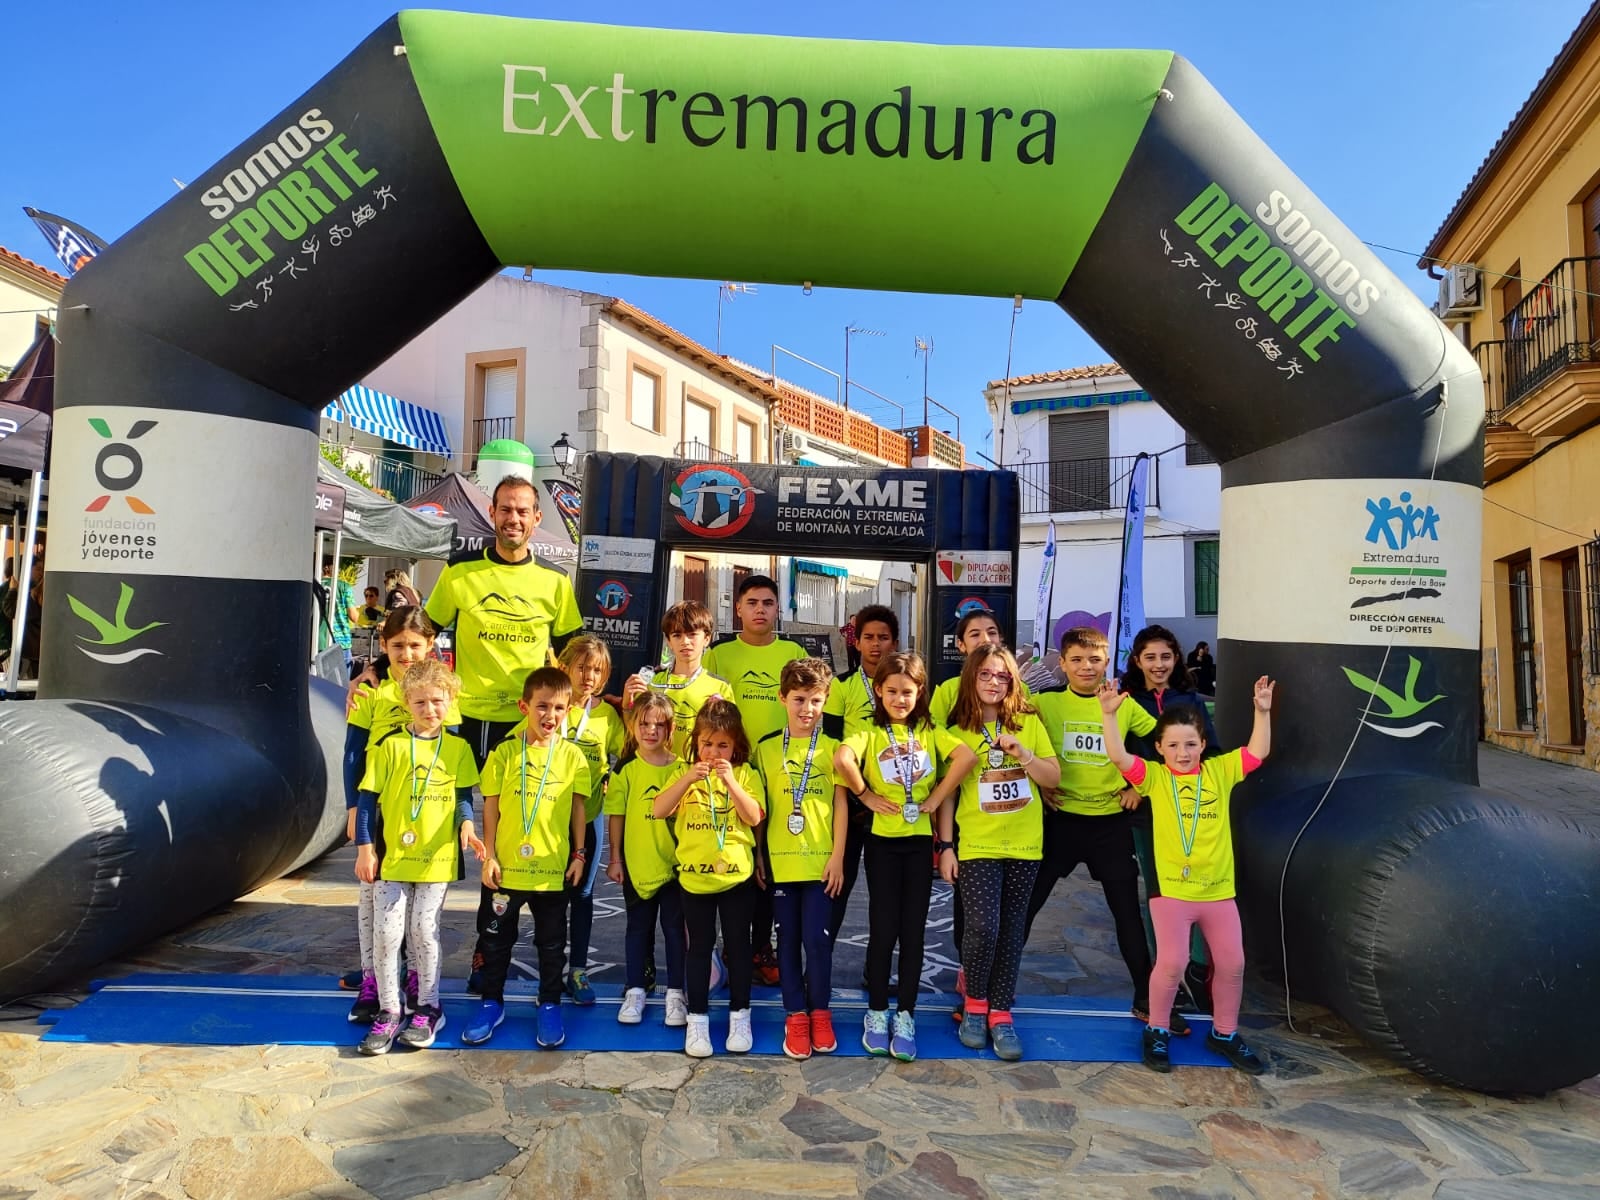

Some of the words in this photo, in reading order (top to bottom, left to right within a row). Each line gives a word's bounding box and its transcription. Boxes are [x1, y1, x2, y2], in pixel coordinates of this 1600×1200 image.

[502, 64, 1057, 166] Extremadura
[183, 132, 379, 297] DEPORTE
[1174, 181, 1357, 362] DEPORTE
[777, 476, 927, 509] FEXME
[777, 507, 850, 521] FEDERACIÓN
[856, 509, 925, 522] EXTREMEÑA
[84, 517, 156, 531] fundación
[777, 521, 793, 533] DE
[795, 521, 850, 535] MONTAÑA
[853, 523, 863, 535] Y
[863, 524, 925, 537] ESCALADA
[82, 530, 157, 546] jóvenes
[82, 549, 89, 560] y
[92, 547, 154, 560] deporte
[1362, 552, 1440, 564] Extremadura
[1349, 577, 1387, 587] Deporte
[1390, 577, 1417, 587] desde
[1419, 577, 1427, 587] la
[1429, 579, 1446, 587] Base
[582, 616, 640, 634] FEXME
[1350, 613, 1405, 623] DIRECCIÓN
[1407, 615, 1445, 624] GENERAL
[478, 630, 536, 643] Montañas
[1075, 735, 1101, 751] 601
[993, 782, 1019, 800] 593
